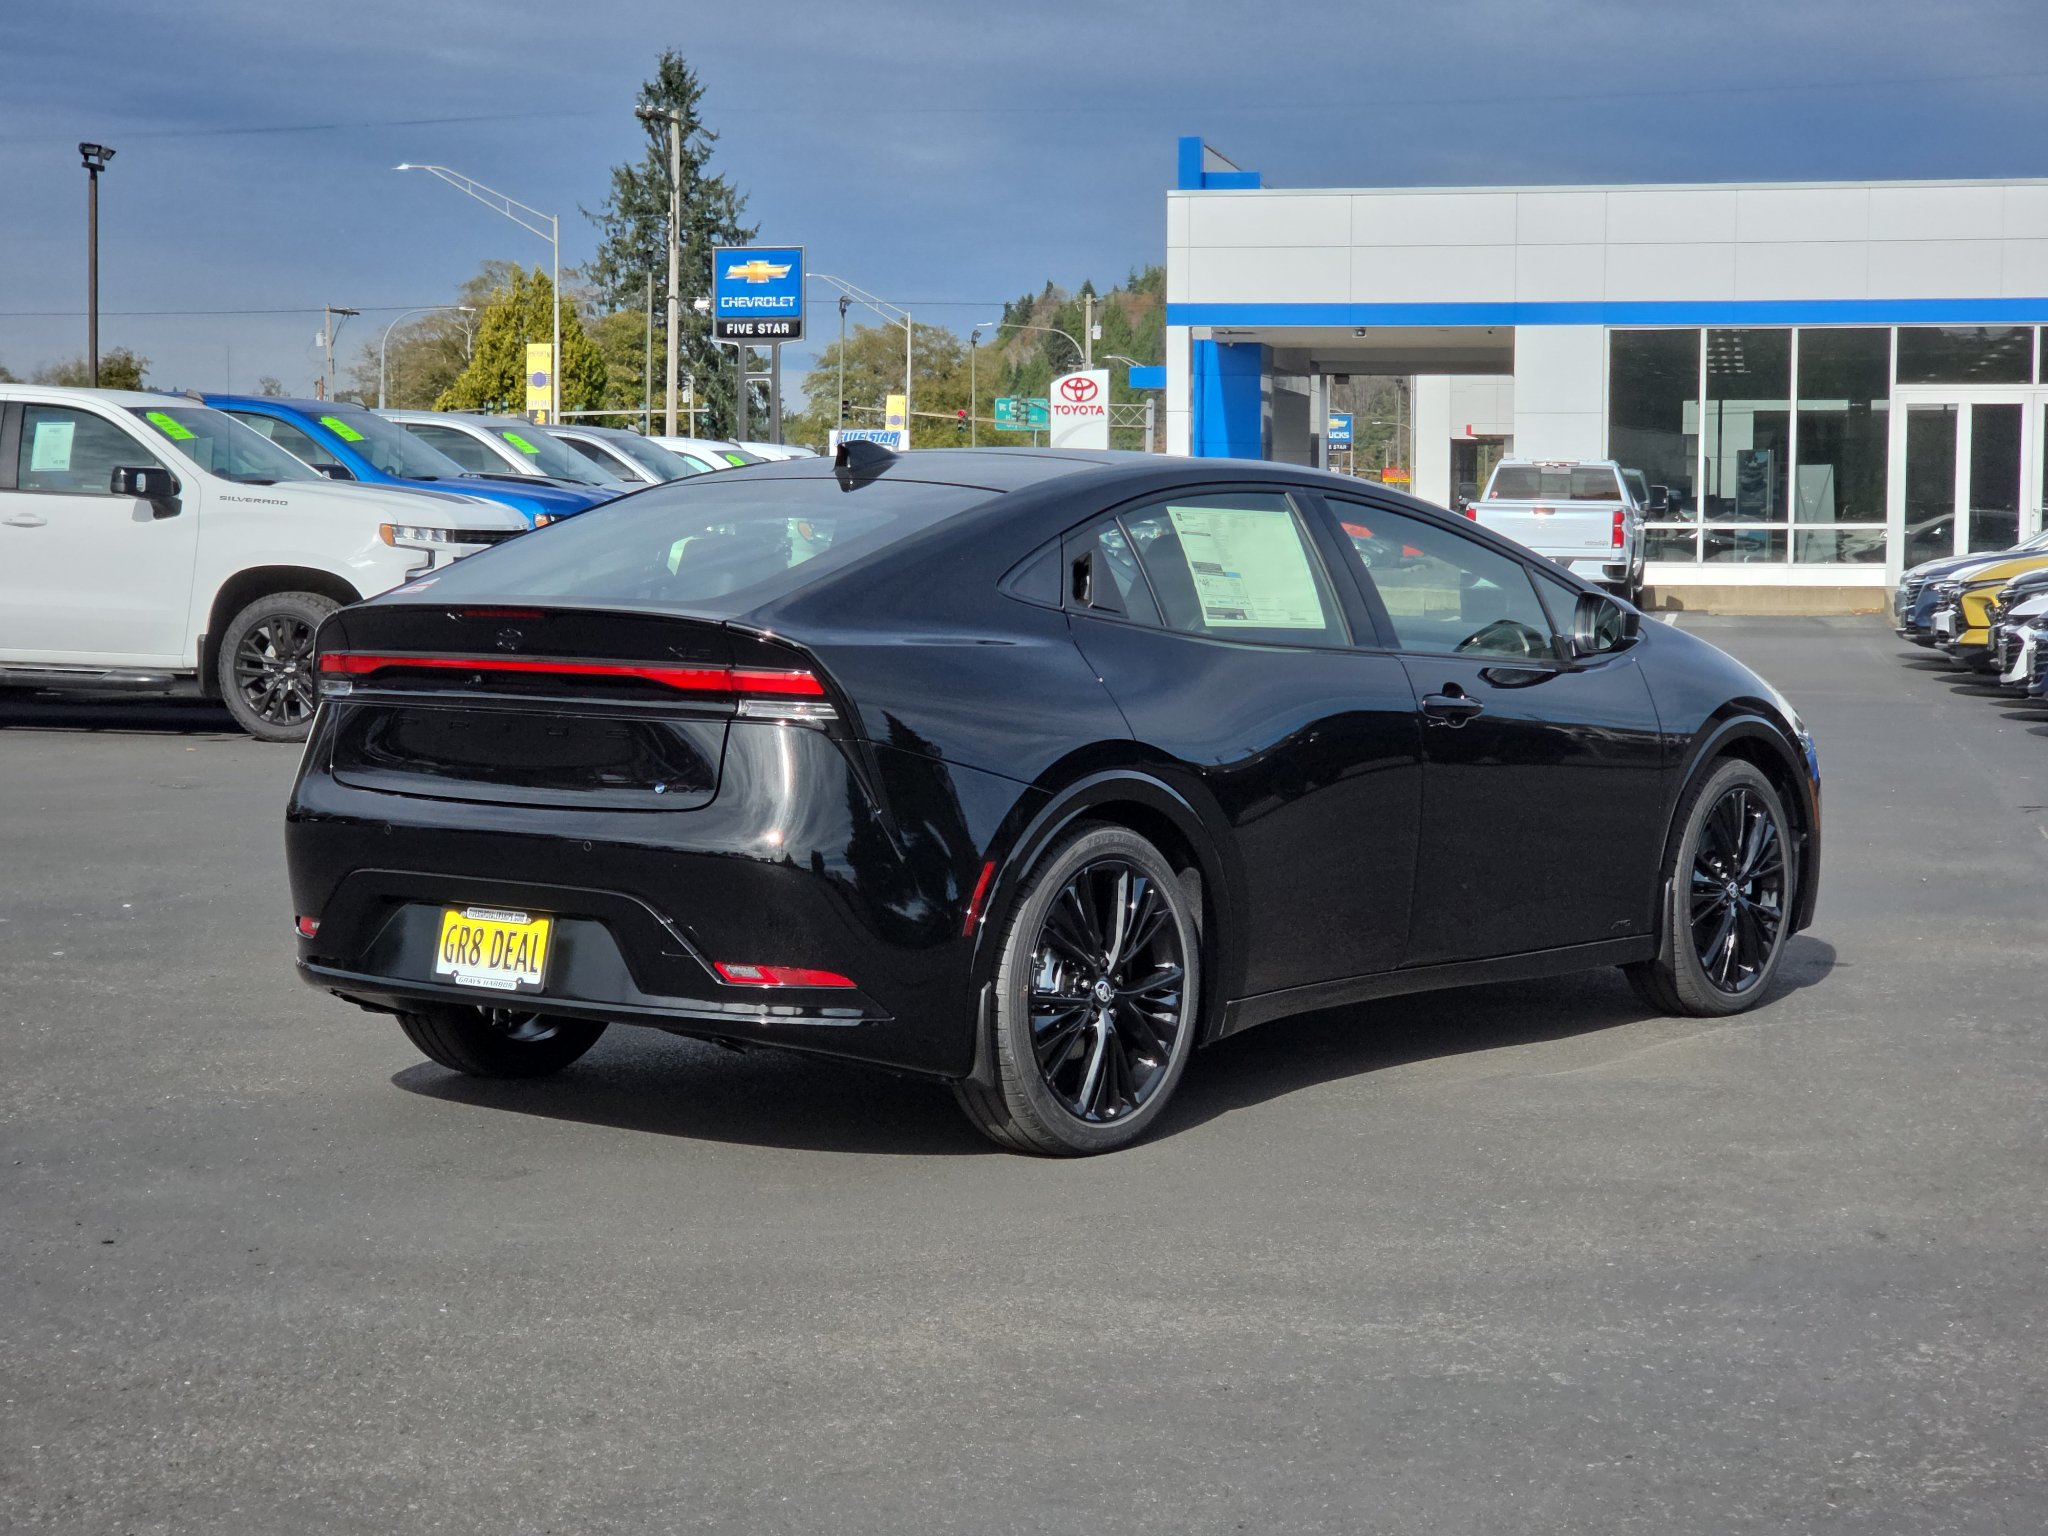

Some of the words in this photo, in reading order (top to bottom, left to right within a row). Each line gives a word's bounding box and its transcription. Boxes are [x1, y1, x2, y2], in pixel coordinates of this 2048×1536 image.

[721, 296, 796, 308] CHEVROLET
[726, 323, 754, 335] FIVE
[757, 323, 790, 335] STAR
[1054, 405, 1105, 416] TOYOTA
[869, 432, 899, 446] STAR
[1328, 431, 1350, 439] UCKS
[219, 495, 288, 506] SILVERADO
[444, 924, 484, 966] GR8
[488, 929, 539, 973] DEAL
